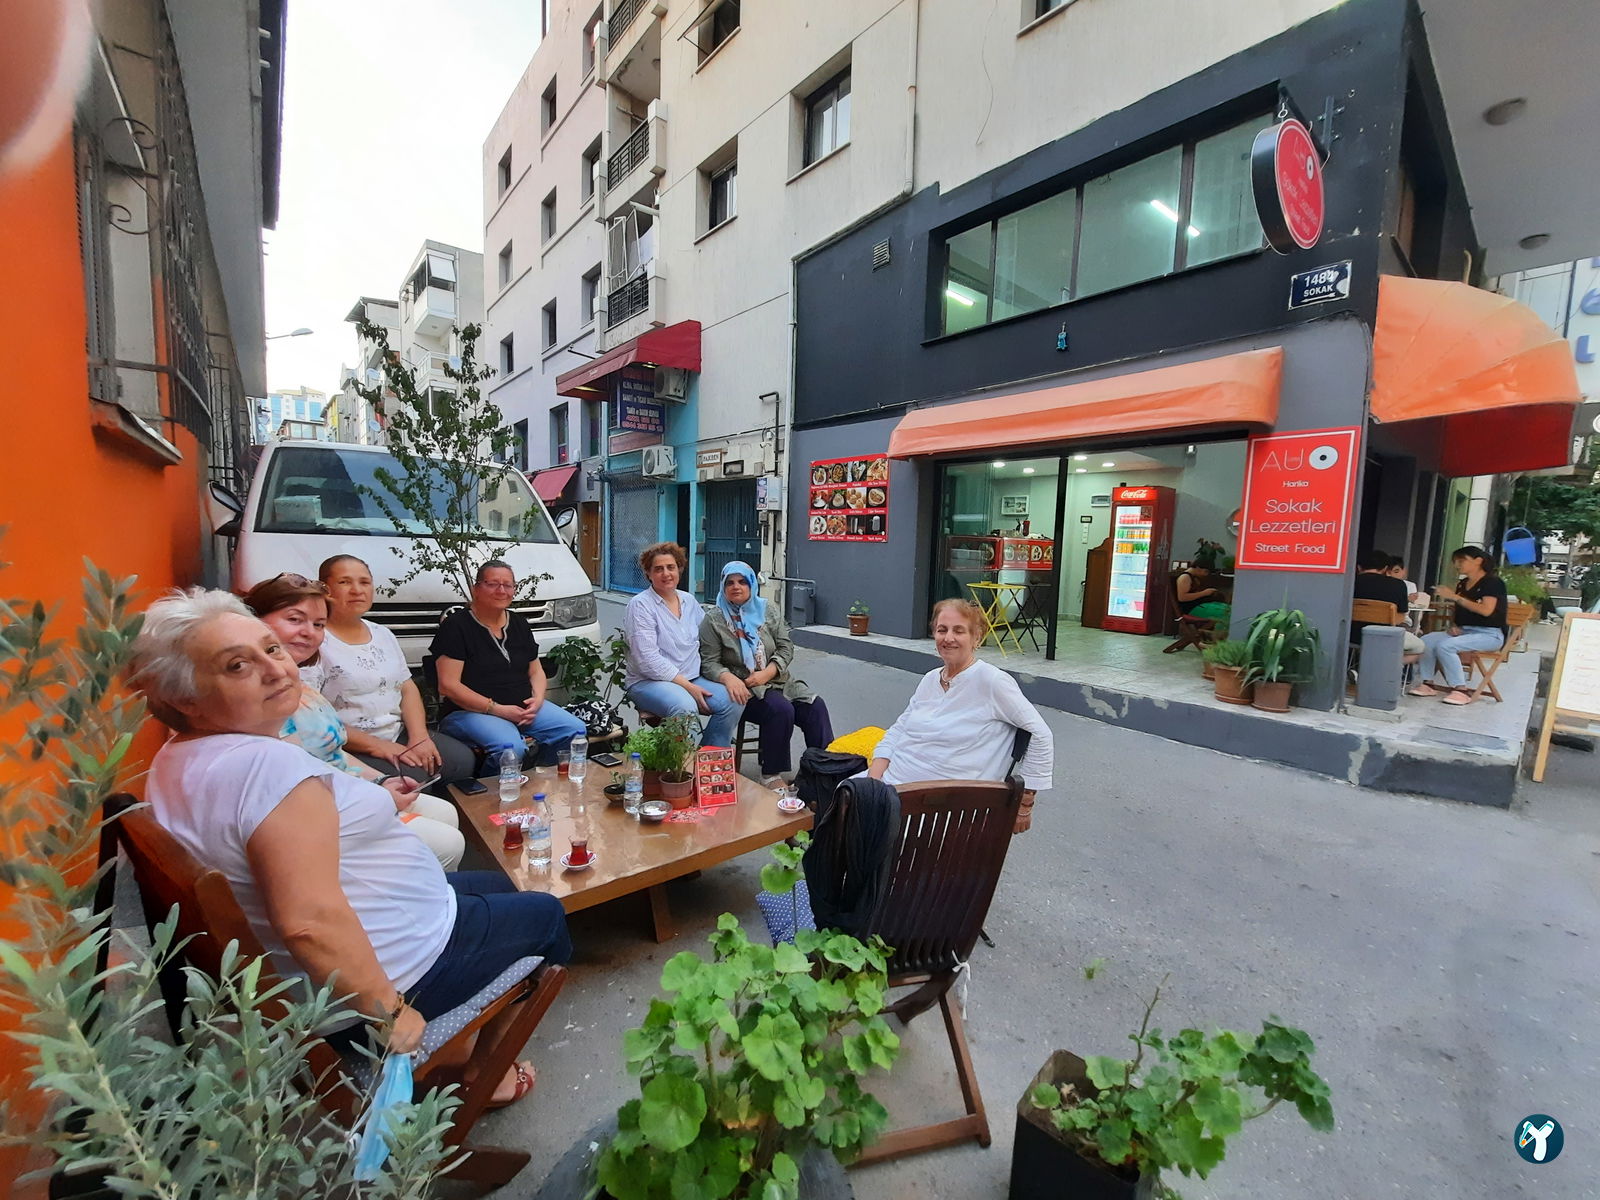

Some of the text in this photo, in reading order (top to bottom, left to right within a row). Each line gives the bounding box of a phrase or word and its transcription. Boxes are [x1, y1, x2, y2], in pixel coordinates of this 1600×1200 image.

[1303, 284, 1333, 297] SOKAK
[1265, 498, 1322, 513] Sokak
[1250, 518, 1336, 534] Lezzetleri
[1255, 542, 1326, 554] Street Food
